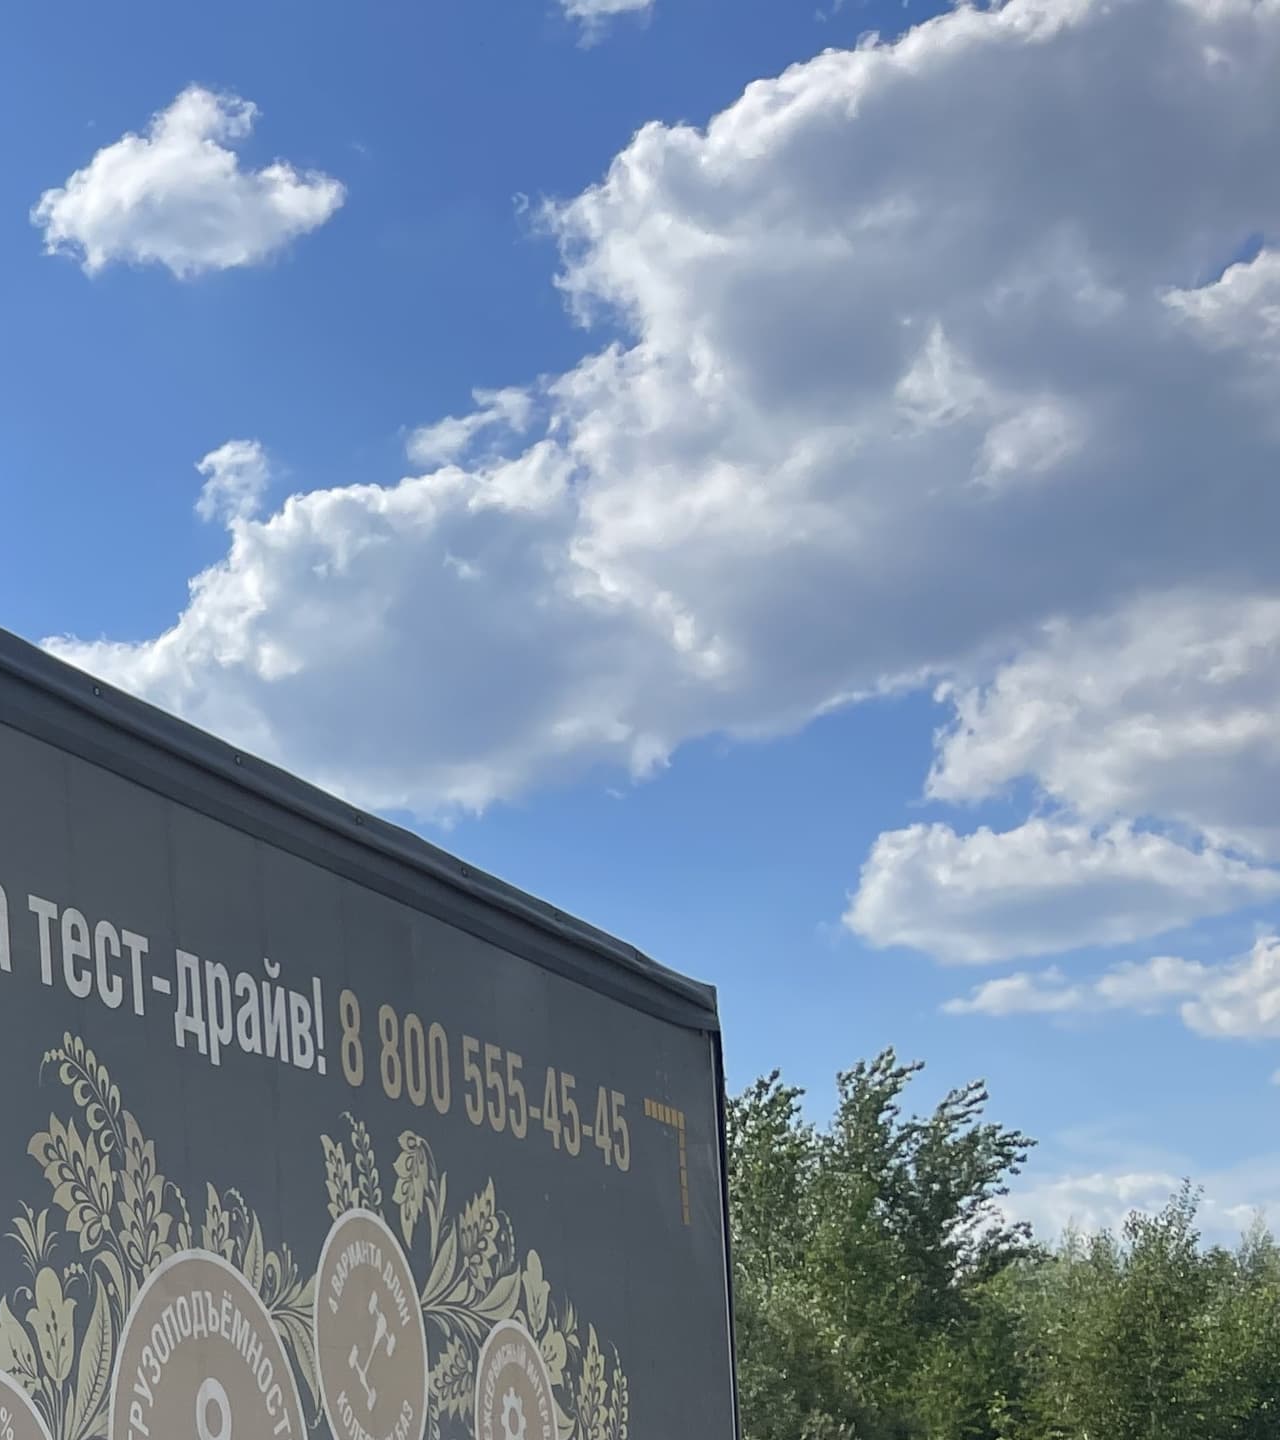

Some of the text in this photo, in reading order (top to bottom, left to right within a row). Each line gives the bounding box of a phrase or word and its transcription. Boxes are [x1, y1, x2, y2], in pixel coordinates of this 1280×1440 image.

[28, 893, 328, 1076] тест-драйв!
[339, 989, 365, 1087] 8
[379, 1004, 452, 1115] 800
[462, 1035, 631, 1172] 555-45-45
[331, 1239, 383, 1292] ВАРИАНТА
